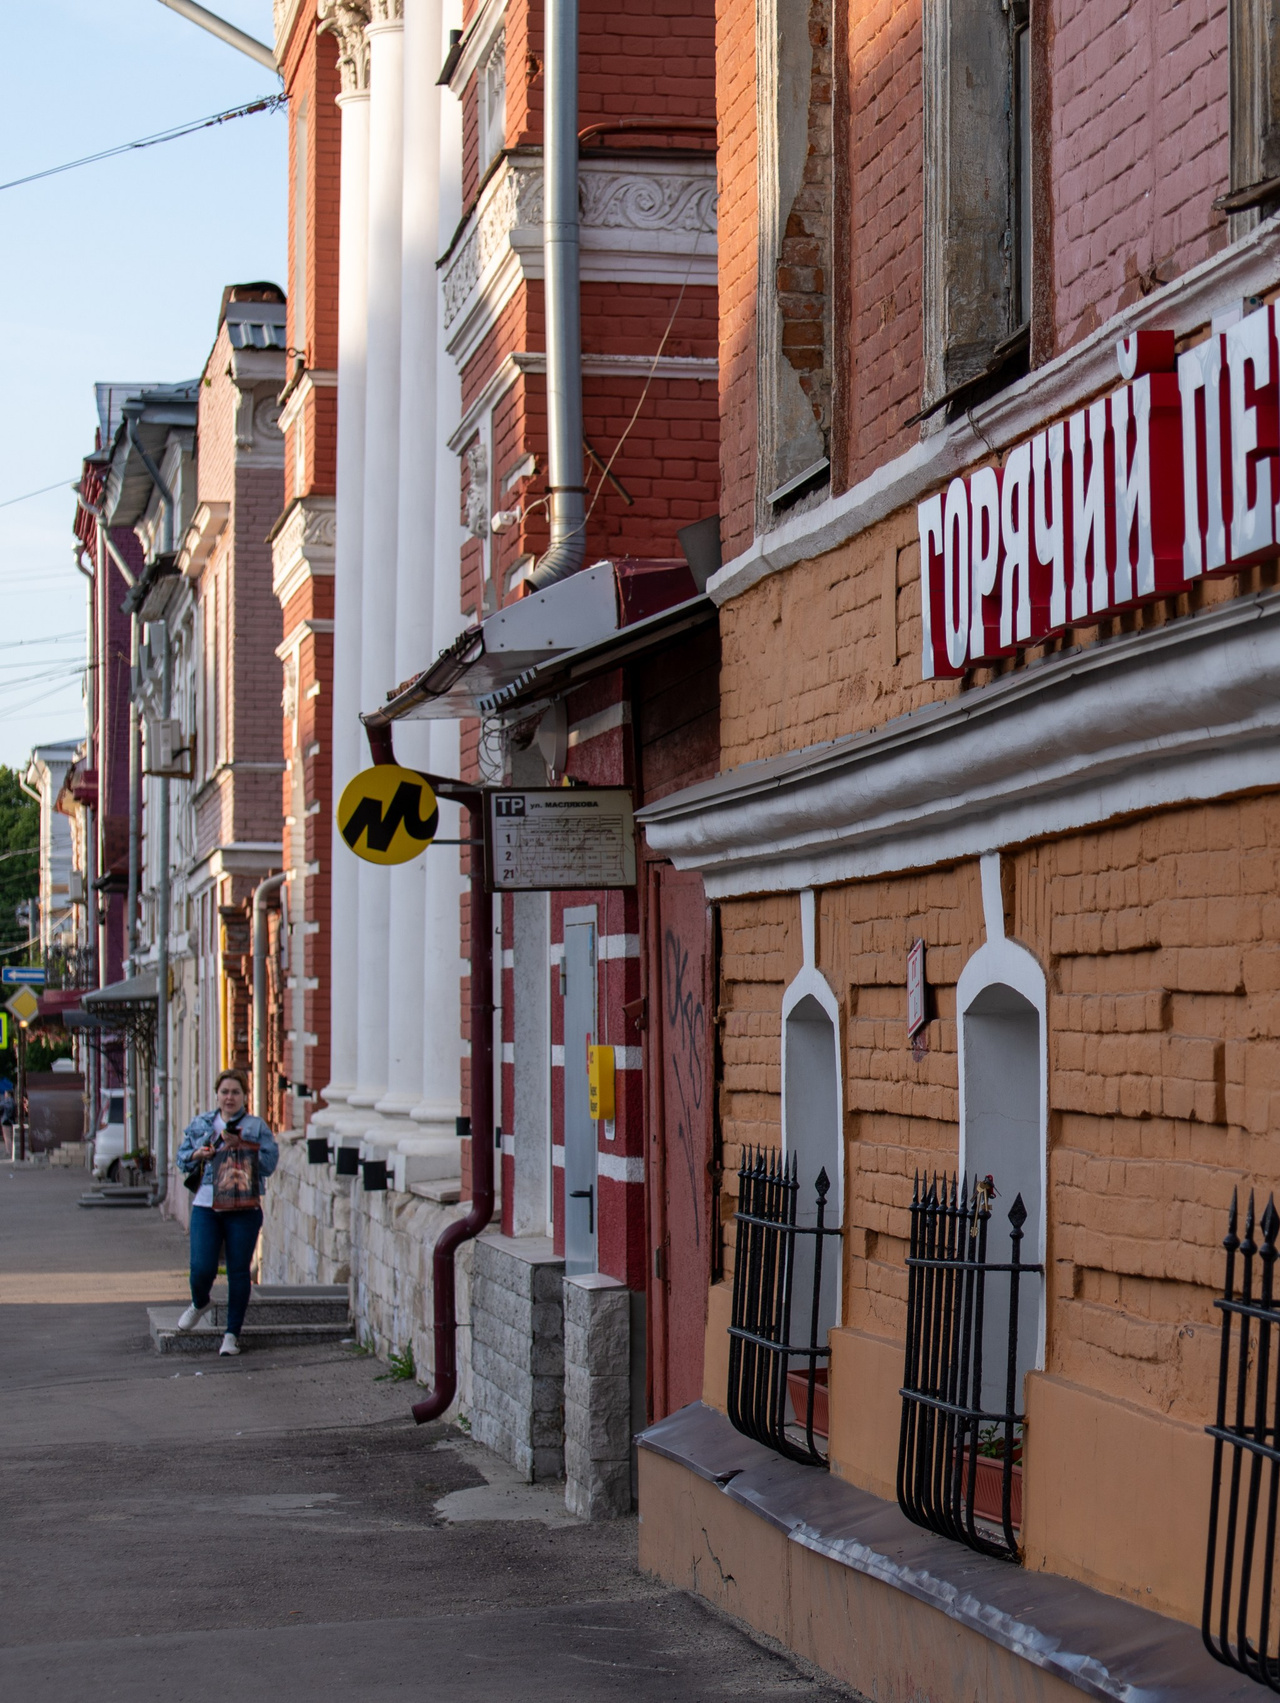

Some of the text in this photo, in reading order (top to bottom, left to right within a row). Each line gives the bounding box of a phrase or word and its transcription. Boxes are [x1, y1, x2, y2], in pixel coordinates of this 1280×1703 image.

[918, 331, 1156, 681] ГОРЯЧИЙ
[545, 801, 599, 809] МАСЛЯКОВА
[505, 834, 512, 844] 1
[505, 851, 512, 861] 2
[503, 869, 515, 879] 21
